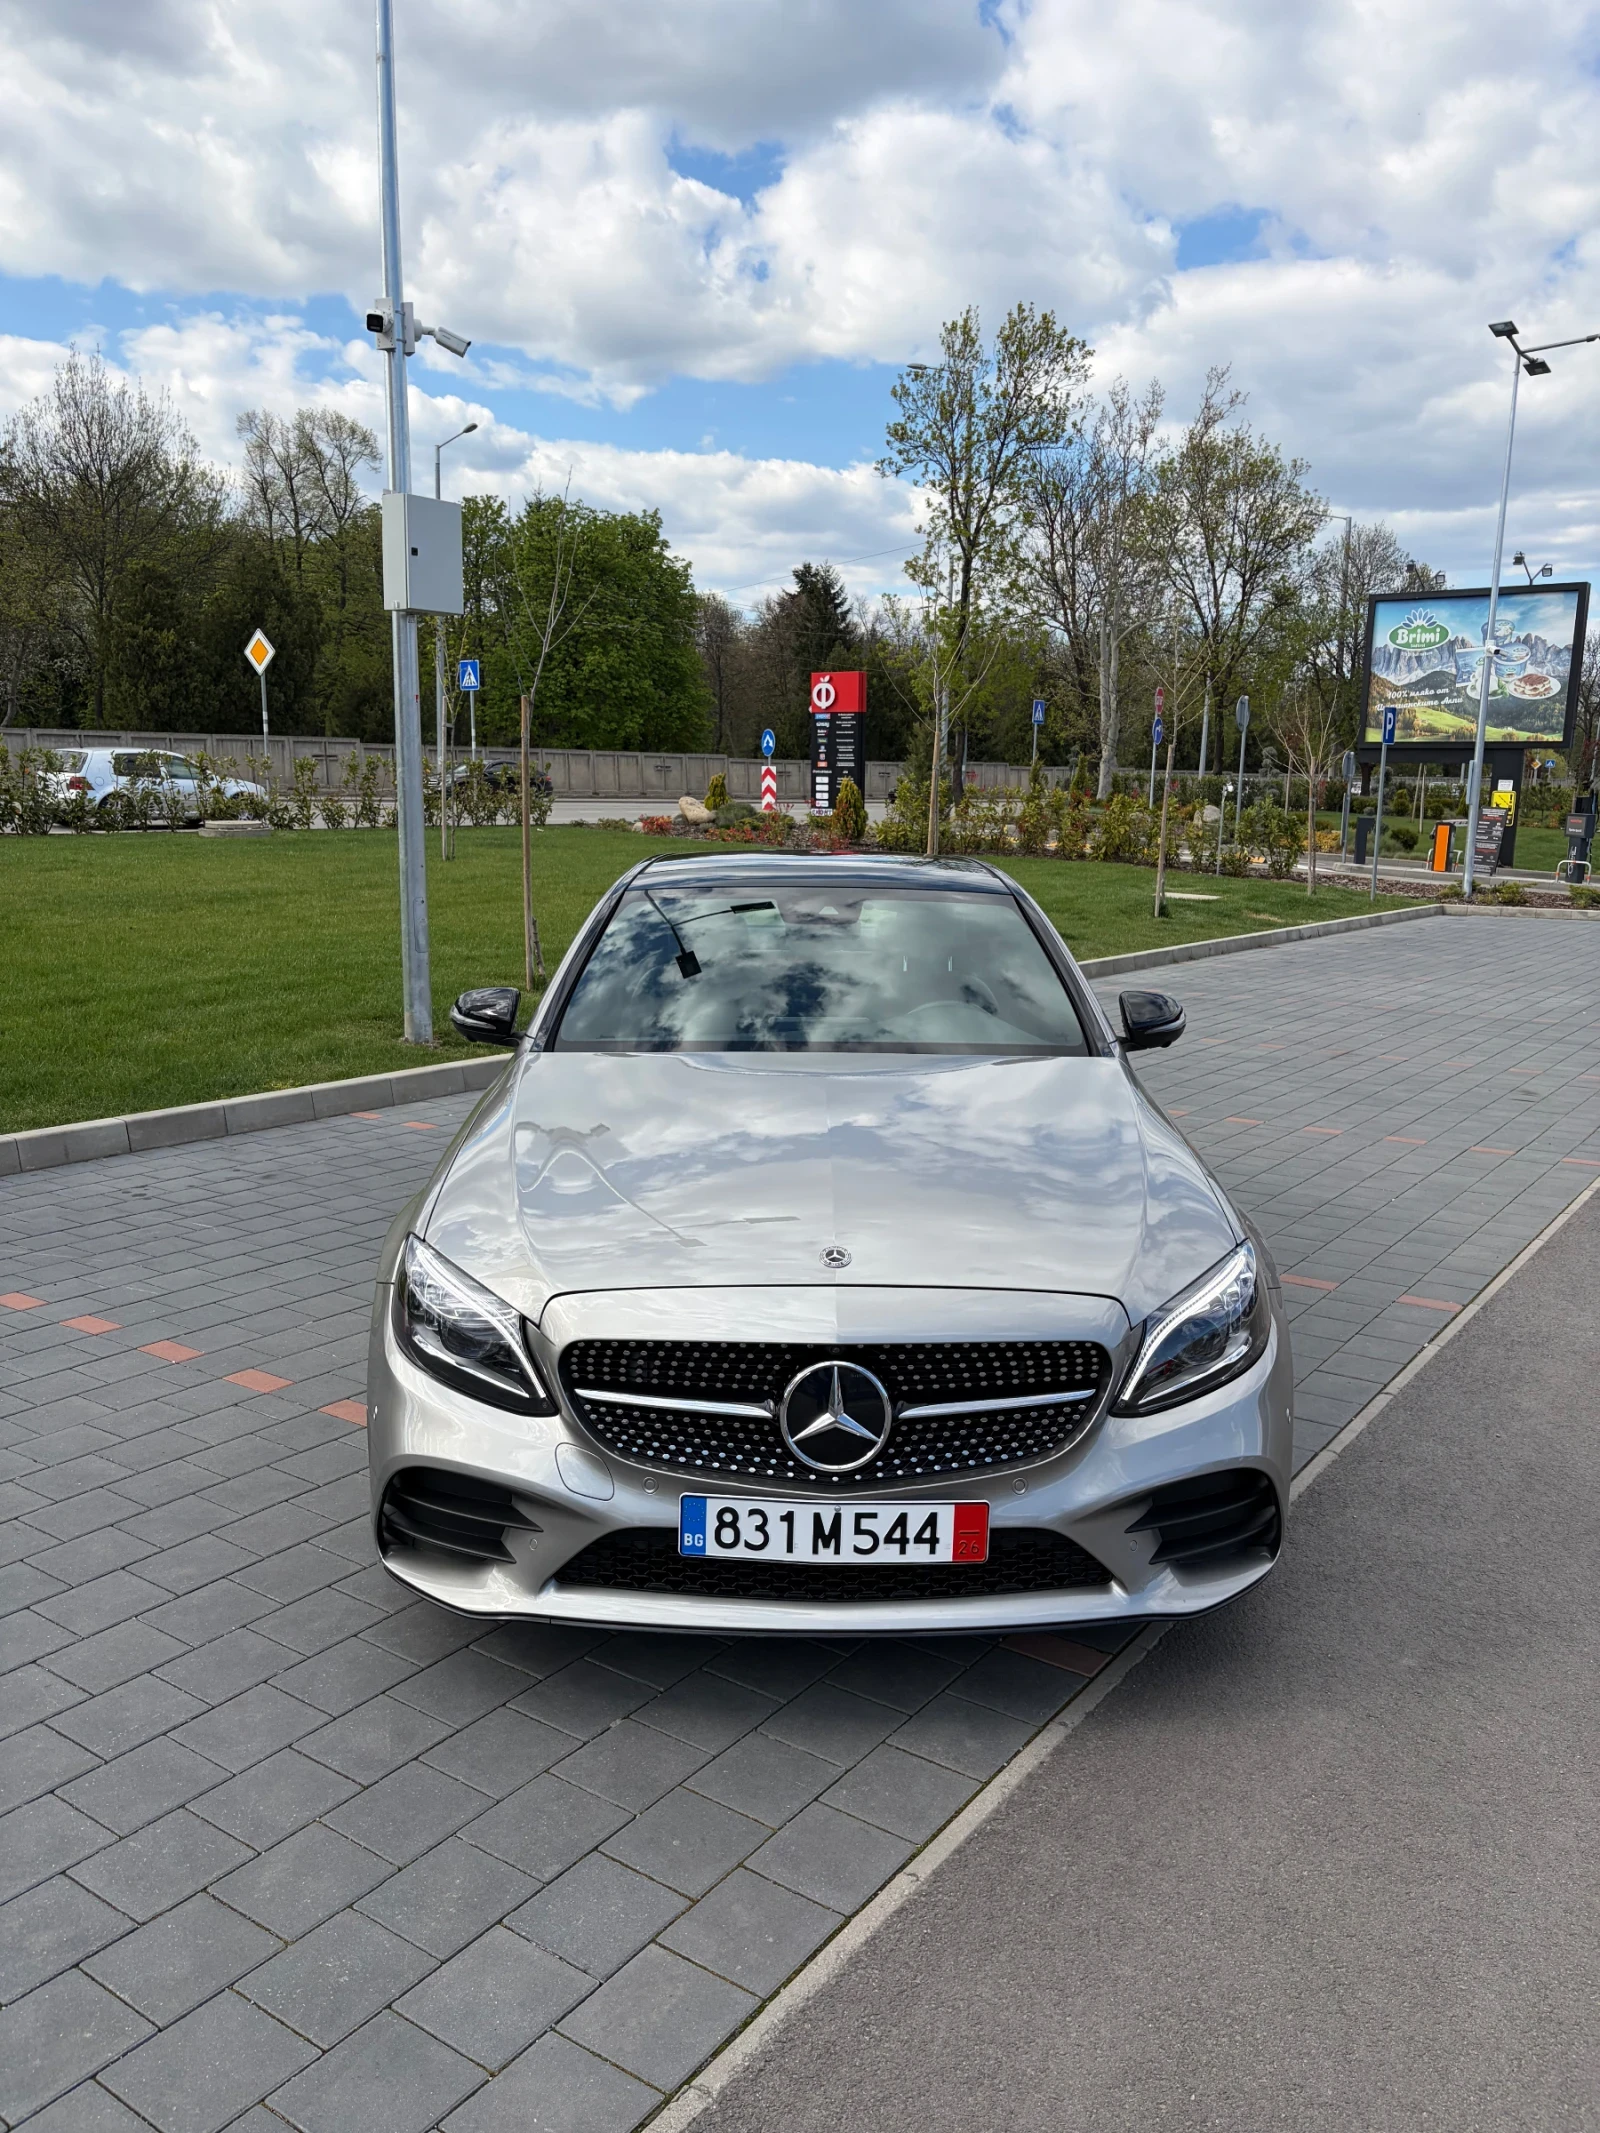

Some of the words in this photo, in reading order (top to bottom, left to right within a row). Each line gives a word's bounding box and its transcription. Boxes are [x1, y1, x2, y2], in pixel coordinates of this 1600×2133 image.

[1396, 627, 1441, 644] Brimi
[1388, 690, 1408, 700] 100%
[1409, 687, 1435, 697] мляко
[1385, 712, 1394, 740] P
[684, 1533, 704, 1547] BG
[958, 1541, 980, 1556] 26
